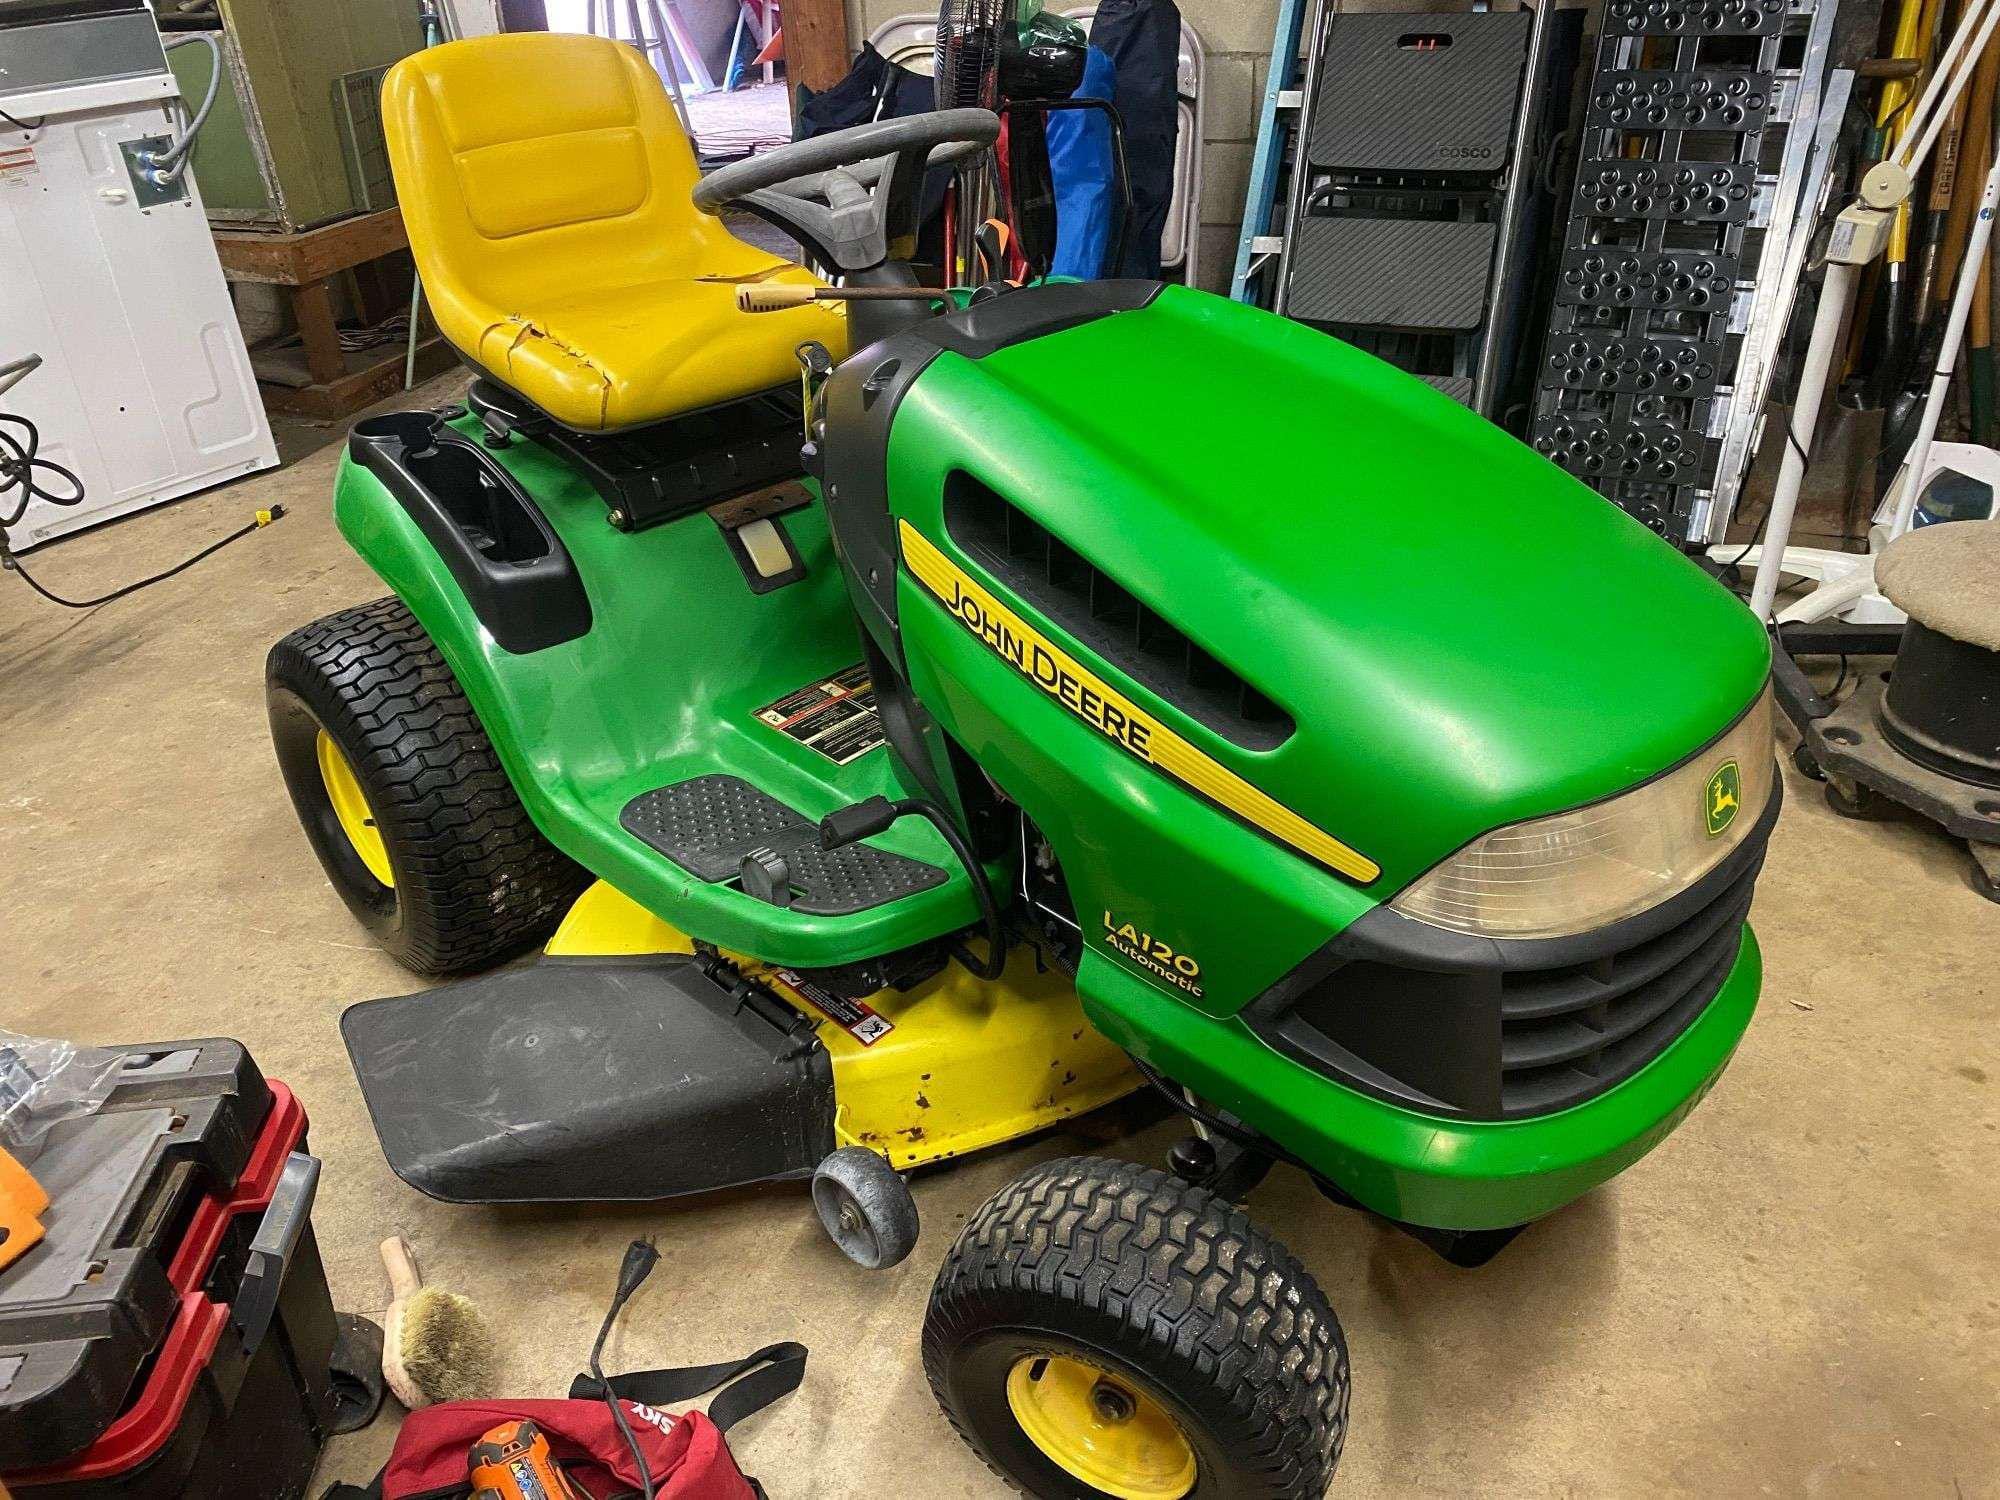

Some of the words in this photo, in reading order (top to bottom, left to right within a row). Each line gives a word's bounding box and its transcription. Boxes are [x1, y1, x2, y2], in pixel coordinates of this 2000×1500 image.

[1439, 146, 1492, 159] COSCO
[945, 580, 1024, 667] JOHN
[1032, 642, 1151, 758] DEERE
[1103, 909, 1200, 977] LA120
[1104, 933, 1203, 997] Automatic
